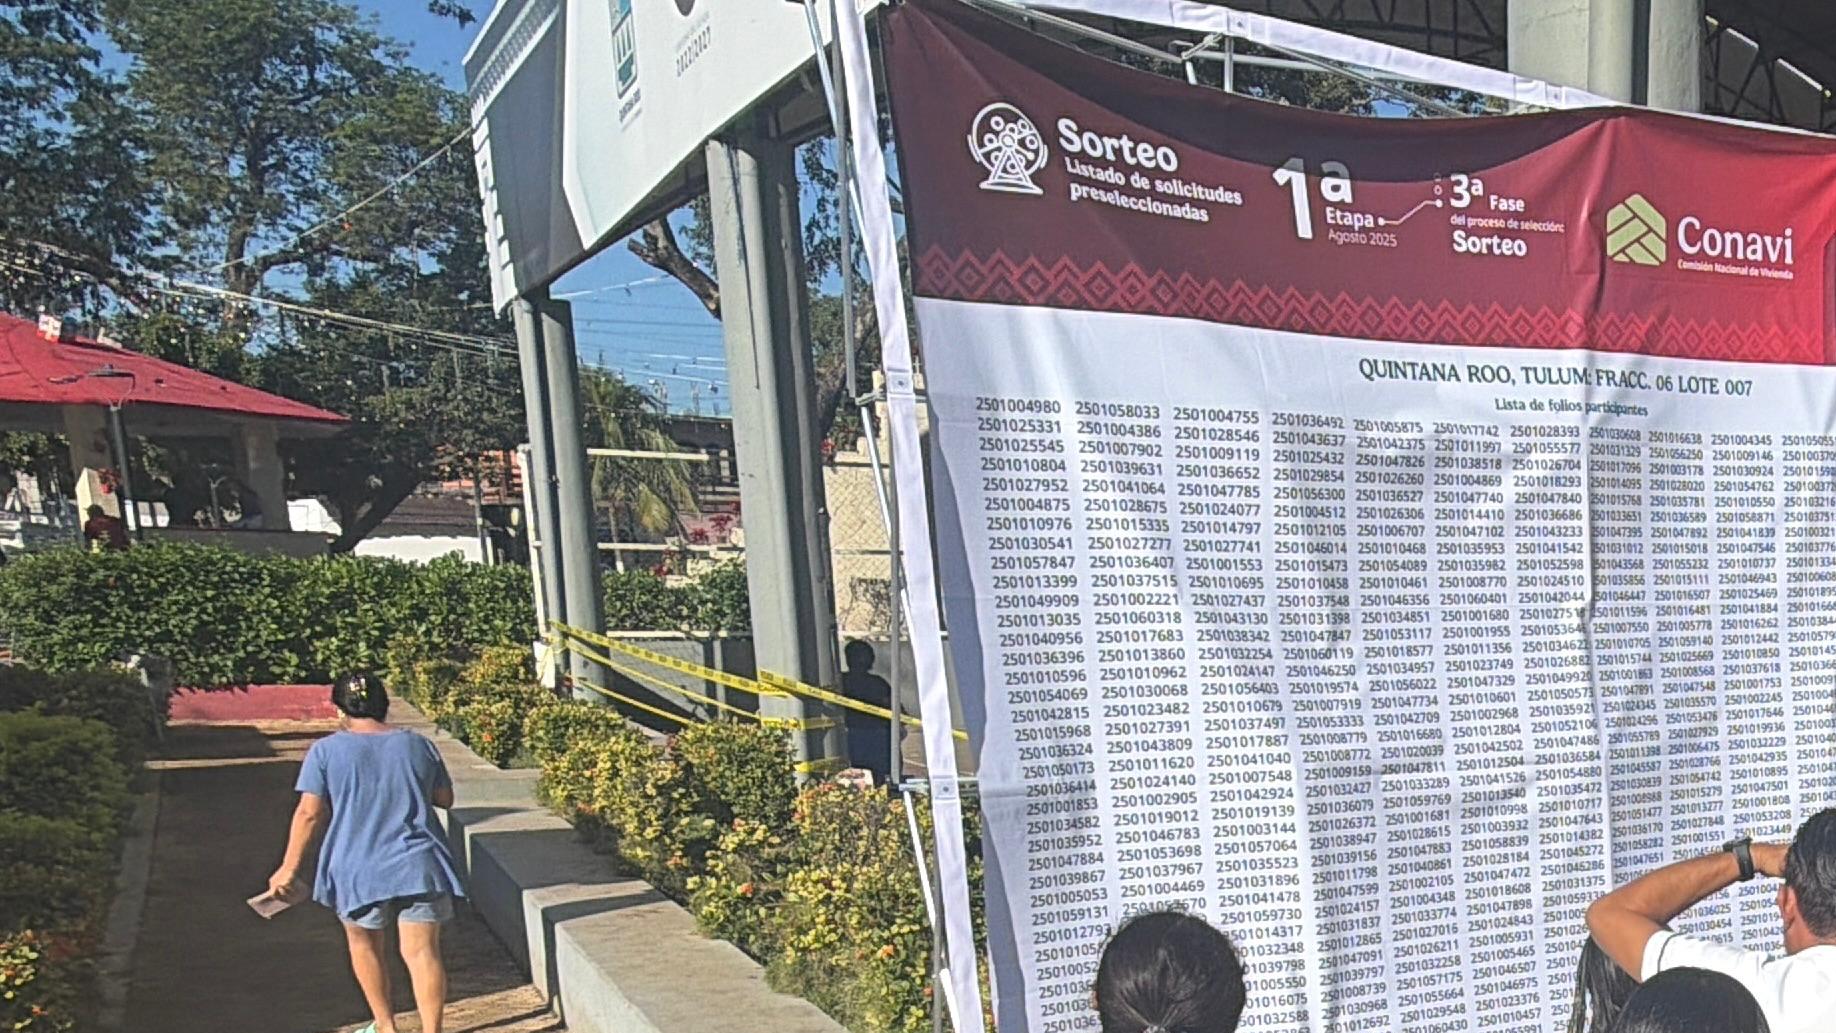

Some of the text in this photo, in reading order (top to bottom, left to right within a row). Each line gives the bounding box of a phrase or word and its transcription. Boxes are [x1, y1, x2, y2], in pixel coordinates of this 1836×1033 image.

[1057, 118, 1179, 172] Sorteo
[1065, 156, 1243, 206] Listado de solicitudes
[1070, 182, 1209, 222] preseleccionadas
[1489, 194, 1526, 212] Fase
[1325, 206, 1375, 231] Etapa
[1450, 213, 1466, 226] del
[1467, 216, 1506, 229] proceso
[1507, 217, 1519, 229] de
[1328, 228, 1398, 248] Agosto 2025
[1453, 229, 1528, 257] Sorteo
[1678, 216, 1794, 265] Conavi
[1714, 262, 1749, 276] Nacional
[1749, 266, 1759, 277] de
[1359, 358, 1461, 382] QUINTANA
[1466, 364, 1516, 386] ROO,
[1595, 368, 1651, 390] FRACC.
[1655, 374, 1674, 392] 06
[1678, 376, 1720, 395] LOTE
[1724, 379, 1753, 398] 007
[976, 397, 1345, 429] 2501004980 2501058033 2501004755 2501036492
[1495, 398, 1649, 418] Lista de folios participantes
[978, 417, 1425, 451] 2501025331 2501004386 2501028546 2501043637 2501042375
[979, 437, 1064, 453] 2501025545
[1079, 441, 1163, 457] 2501007902
[1175, 445, 1260, 461] 2501009119
[1273, 449, 1344, 465] 2501025432
[1355, 453, 1425, 467] 2501047826
[981, 457, 1067, 472] 2501010804
[1081, 460, 1162, 476] 2501039631
[1176, 464, 1260, 479] 2501036652
[1273, 468, 1344, 483] 2501029854
[983, 477, 1069, 492] 2501027952
[1083, 479, 1165, 495] 2501041064
[1178, 483, 1260, 498] 2501047785
[1434, 491, 1503, 503] 2501047740
[985, 497, 1260, 516] 2501004875 2501028675 2501024077
[987, 517, 1583, 537] 2501010976 2501015335 2501014797 2501006707 2501047102 2501043233
[989, 537, 1583, 554] 2501030541 2501027277 2501027741 2501041542
[991, 556, 1175, 569] 2501057847 2501036407
[993, 574, 1427, 589] 2501013399 2501037515 2501010461
[995, 593, 1178, 609] 2501049909 2501002221
[997, 611, 1181, 628] 2501013035 2501060318
[999, 625, 1511, 647] 2501040956 2501017683 2501053117 2501001955
[1002, 642, 1512, 666] 2501036396 2501013860 2501011356
[1005, 664, 1356, 685] 2501010596 2501010962 2501046250
[1008, 684, 1188, 704] 2501054069 2501030068
[1011, 702, 1190, 723] 2501042815 2501023482
[1015, 721, 1189, 742] 2501015968 2501027391
[1018, 734, 1289, 761] 2501036324 2501043809 2501017887
[1022, 739, 1523, 779] 2501050173 2501011620 2501041040 2501008772 2501042502
[1111, 770, 1292, 790] 2501024140 2501007548
[1027, 777, 1450, 815] 2501001853 2501002905 2501042924 2501033289
[1027, 805, 1294, 835] 2501034582 2501019012 2501019139
[1028, 834, 1102, 853] 2501035952
[1116, 827, 1200, 844] 2501046783
[1213, 823, 1296, 837] 2501003144
[1029, 840, 1297, 871] 2501047884 2501053698 2501057064
[1029, 857, 1298, 890] 2501039867 2501037967 2501035523
[1030, 874, 1299, 908] 2501005053 2501004469 2501031896
[1032, 867, 1605, 926] 2501059131 2501002105 2501047472 2501031375
[1221, 899, 1379, 925] 2501059730 2501024157
[1392, 907, 1457, 925] 2501033774
[1317, 932, 1382, 952] 2501012865
